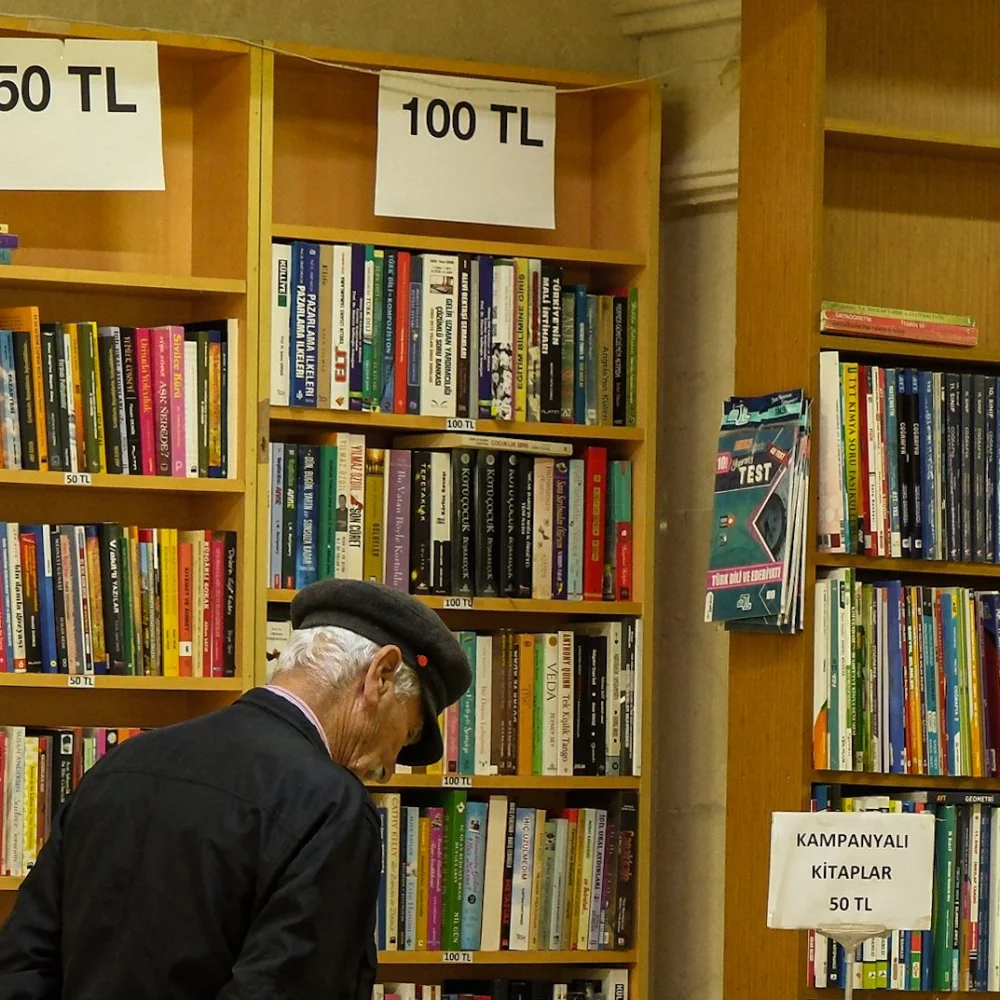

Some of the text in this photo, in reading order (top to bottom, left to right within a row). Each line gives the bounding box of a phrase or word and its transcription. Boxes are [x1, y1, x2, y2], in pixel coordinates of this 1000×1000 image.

[68, 66, 137, 112] TL
[402, 97, 544, 148] 100 TL
[278, 260, 287, 293] KÜLLİYE
[296, 286, 305, 339] PAZARLAMA
[445, 298, 453, 318] GELİR
[541, 277, 549, 354] MALİ İNTİHARI
[141, 339, 151, 413] Umuda Yolculuk
[444, 348, 452, 395] YARDIMCILIĞI
[159, 381, 169, 458] AŞK NEREDE?
[448, 419, 474, 428] 100 TL
[849, 401, 857, 434] KİMYA
[351, 446, 362, 469] YILMAZ
[67, 474, 89, 484] 50 TL
[739, 463, 771, 485] TEST
[461, 468, 471, 532] KÖTÜ ÇOCUK
[486, 469, 495, 533] KÖTÜ ÇOCUK
[350, 508, 360, 523] SON
[712, 567, 781, 587] TÜRK DİLİ VE EDEBİYATI
[111, 581, 119, 613] YAZILAR
[446, 597, 472, 607] 100 TL
[70, 676, 93, 685] 50 TL
[547, 663, 558, 701] VEDA
[562, 711, 570, 735] Kişilik
[560, 738, 569, 761] Tango
[444, 776, 470, 785] 100 TL
[797, 833, 908, 848] KAMPANYALI
[812, 862, 891, 879] KİTAPLAR
[830, 897, 872, 911] 50 TL
[445, 952, 471, 962] 100 TL
